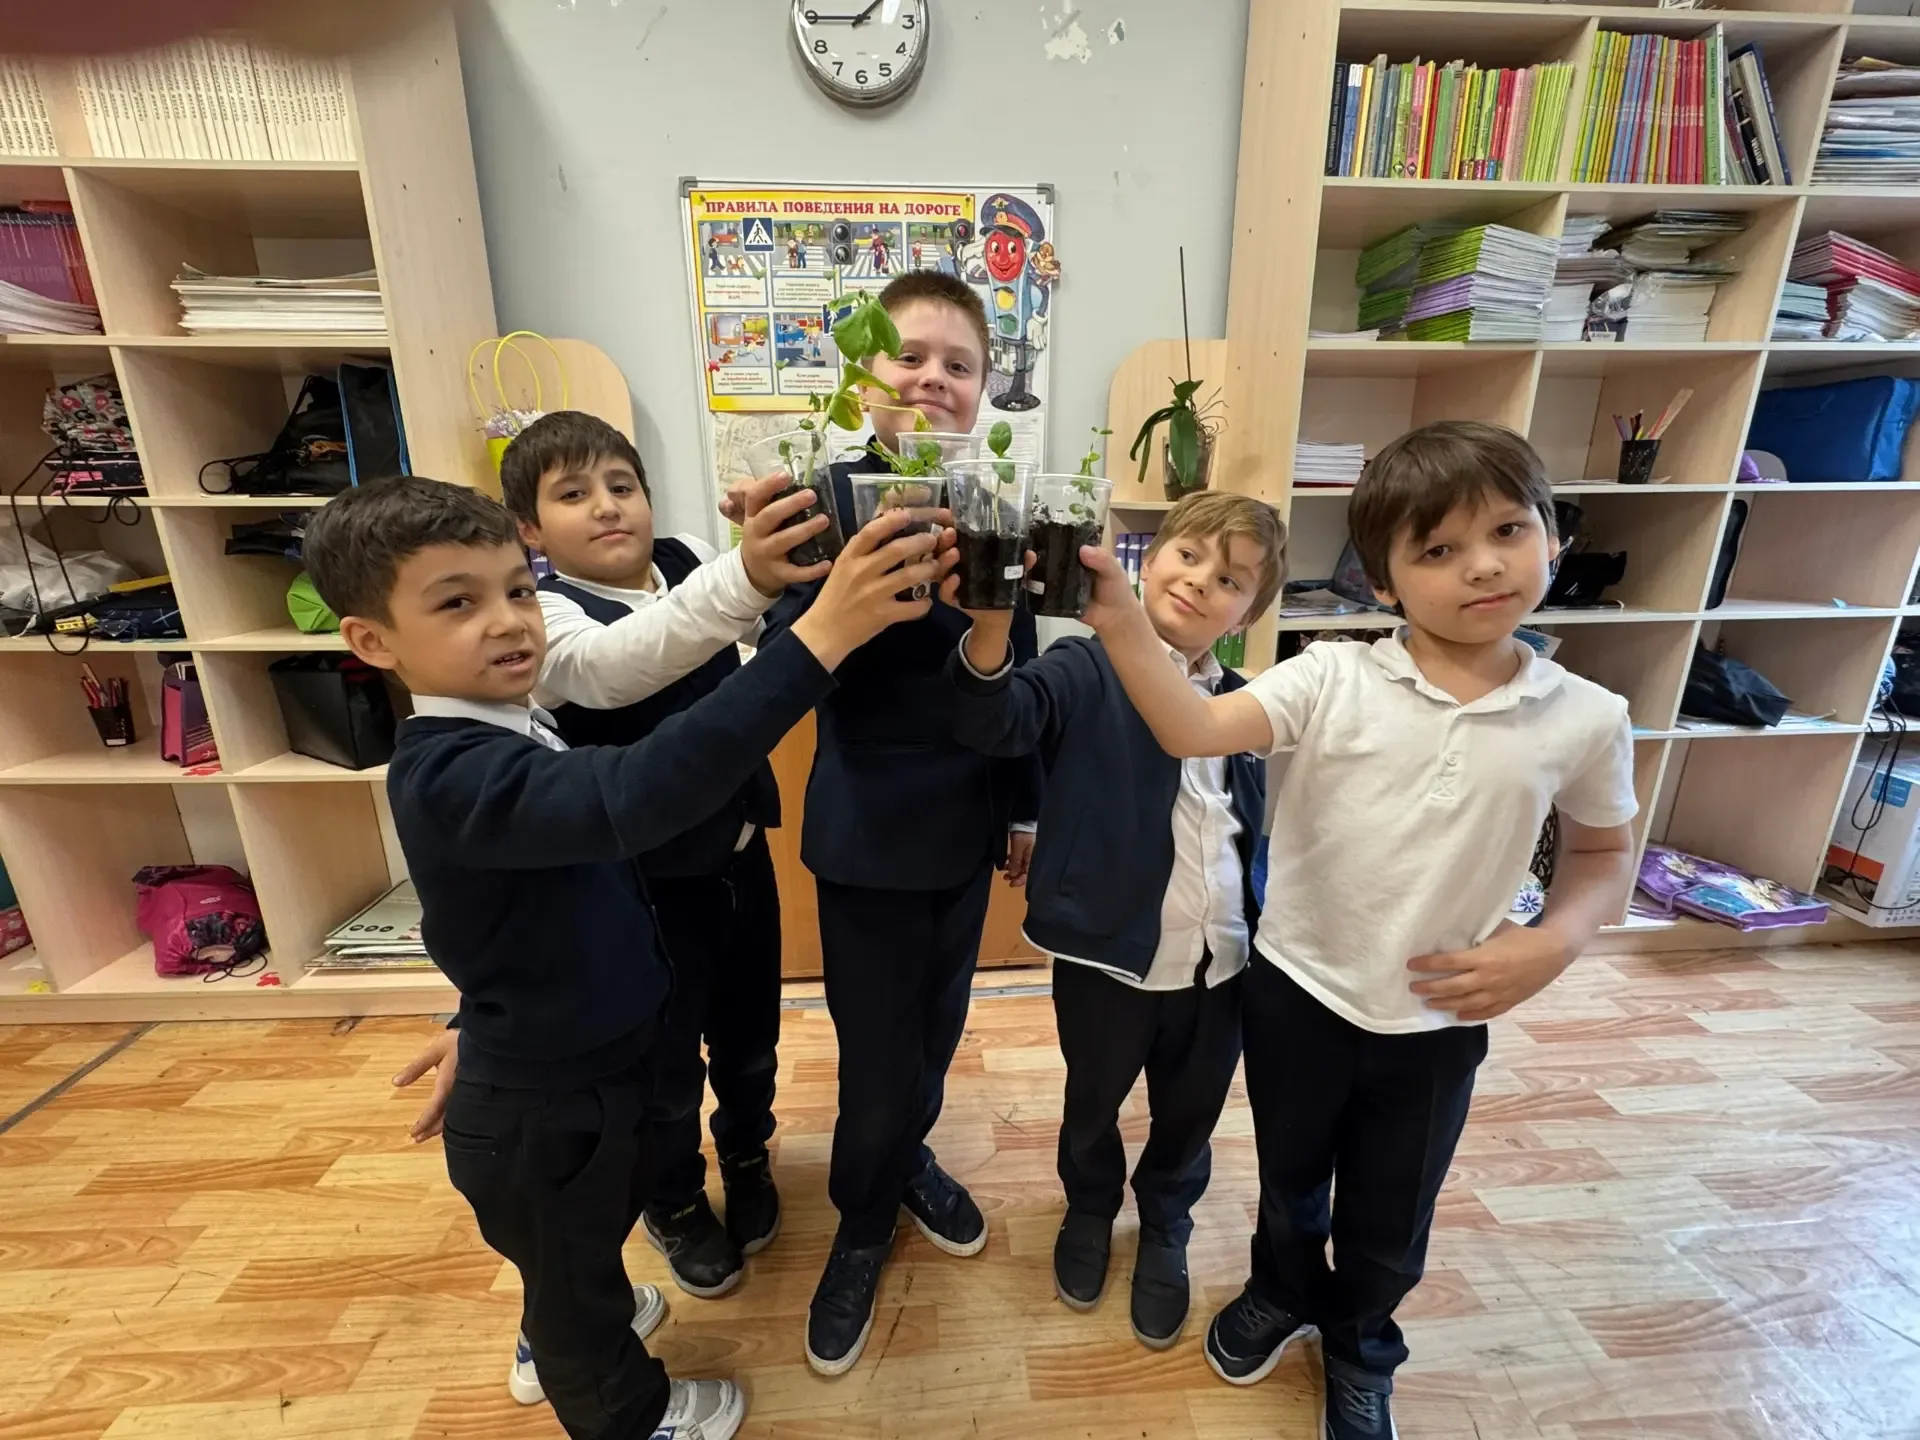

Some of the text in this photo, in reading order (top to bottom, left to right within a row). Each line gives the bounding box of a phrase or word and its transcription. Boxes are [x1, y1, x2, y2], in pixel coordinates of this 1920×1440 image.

[902, 15, 915, 30] 3
[814, 40, 828, 54] 8
[895, 42, 908, 56] 4
[832, 61, 844, 76] 7
[879, 63, 892, 77] 5
[855, 70, 868, 84] 6
[705, 201, 961, 216] ПРАВИЛА ПОВЕДЕНИЯ НА ДОРОГЕ
